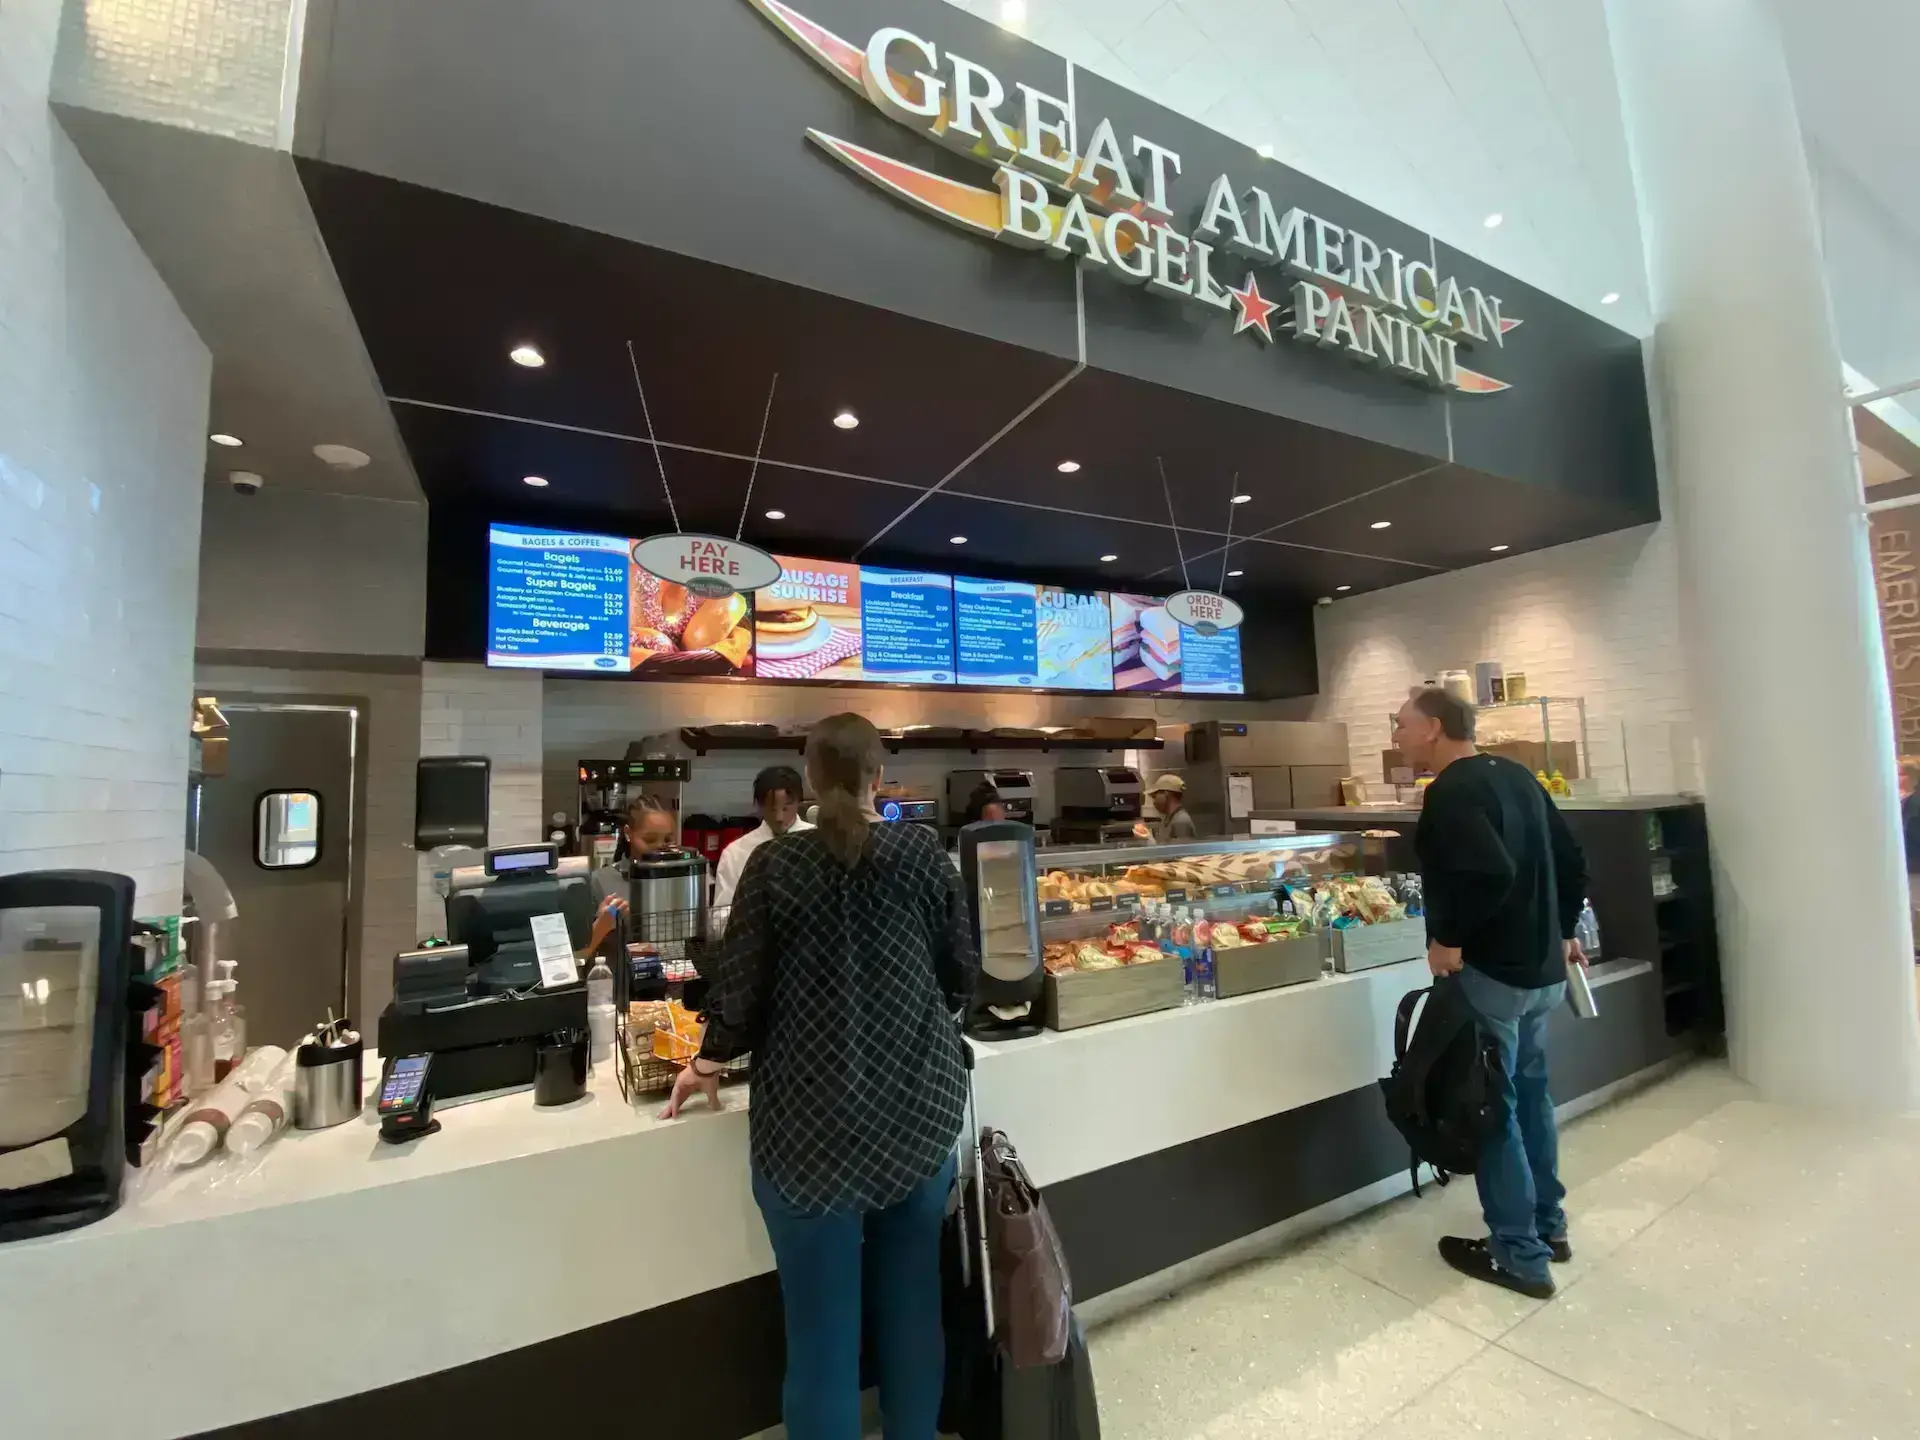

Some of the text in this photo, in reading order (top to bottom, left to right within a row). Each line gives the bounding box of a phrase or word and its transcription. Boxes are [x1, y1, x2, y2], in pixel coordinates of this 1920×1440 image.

[864, 26, 1505, 347] GREAT AMERICAN
[998, 165, 1462, 391] BAGEL PANINI
[521, 538, 556, 546] BAGELS
[558, 538, 565, 546] &
[567, 538, 600, 547] COFFEE
[691, 540, 729, 558] PAY
[543, 551, 580, 564] Bagels
[496, 558, 523, 566] Gourmet
[545, 562, 568, 570] Cheese
[568, 564, 585, 573] Bagel
[680, 555, 740, 576] HERE
[496, 566, 523, 574] Gourmet
[524, 568, 542, 577] Bagel
[551, 571, 568, 579] Butter
[574, 573, 587, 581] Jelly
[604, 574, 623, 583] $3.19
[779, 569, 849, 588] AUSAGE
[525, 576, 597, 592] Super Bagels
[496, 586, 525, 594] Blueberry
[533, 588, 563, 596] Cinnamon
[603, 592, 623, 601] $2.79
[769, 584, 848, 604] SUNRISE
[890, 590, 924, 601] Breakfast
[1040, 590, 1104, 612] CUBAN
[496, 594, 518, 602] Asiago
[518, 595, 536, 603] Bagel
[603, 600, 623, 609] $3.79
[1186, 595, 1224, 609] ORDER
[603, 608, 623, 616] $3.79
[1190, 606, 1222, 620] HERE
[532, 618, 590, 632] Beverages
[495, 627, 521, 635] Seattle's
[534, 629, 554, 637] Coffee
[603, 632, 623, 640] $2.59
[507, 636, 539, 644] Chocolate
[603, 640, 623, 648] $3.39
[603, 648, 623, 656] $2.59
